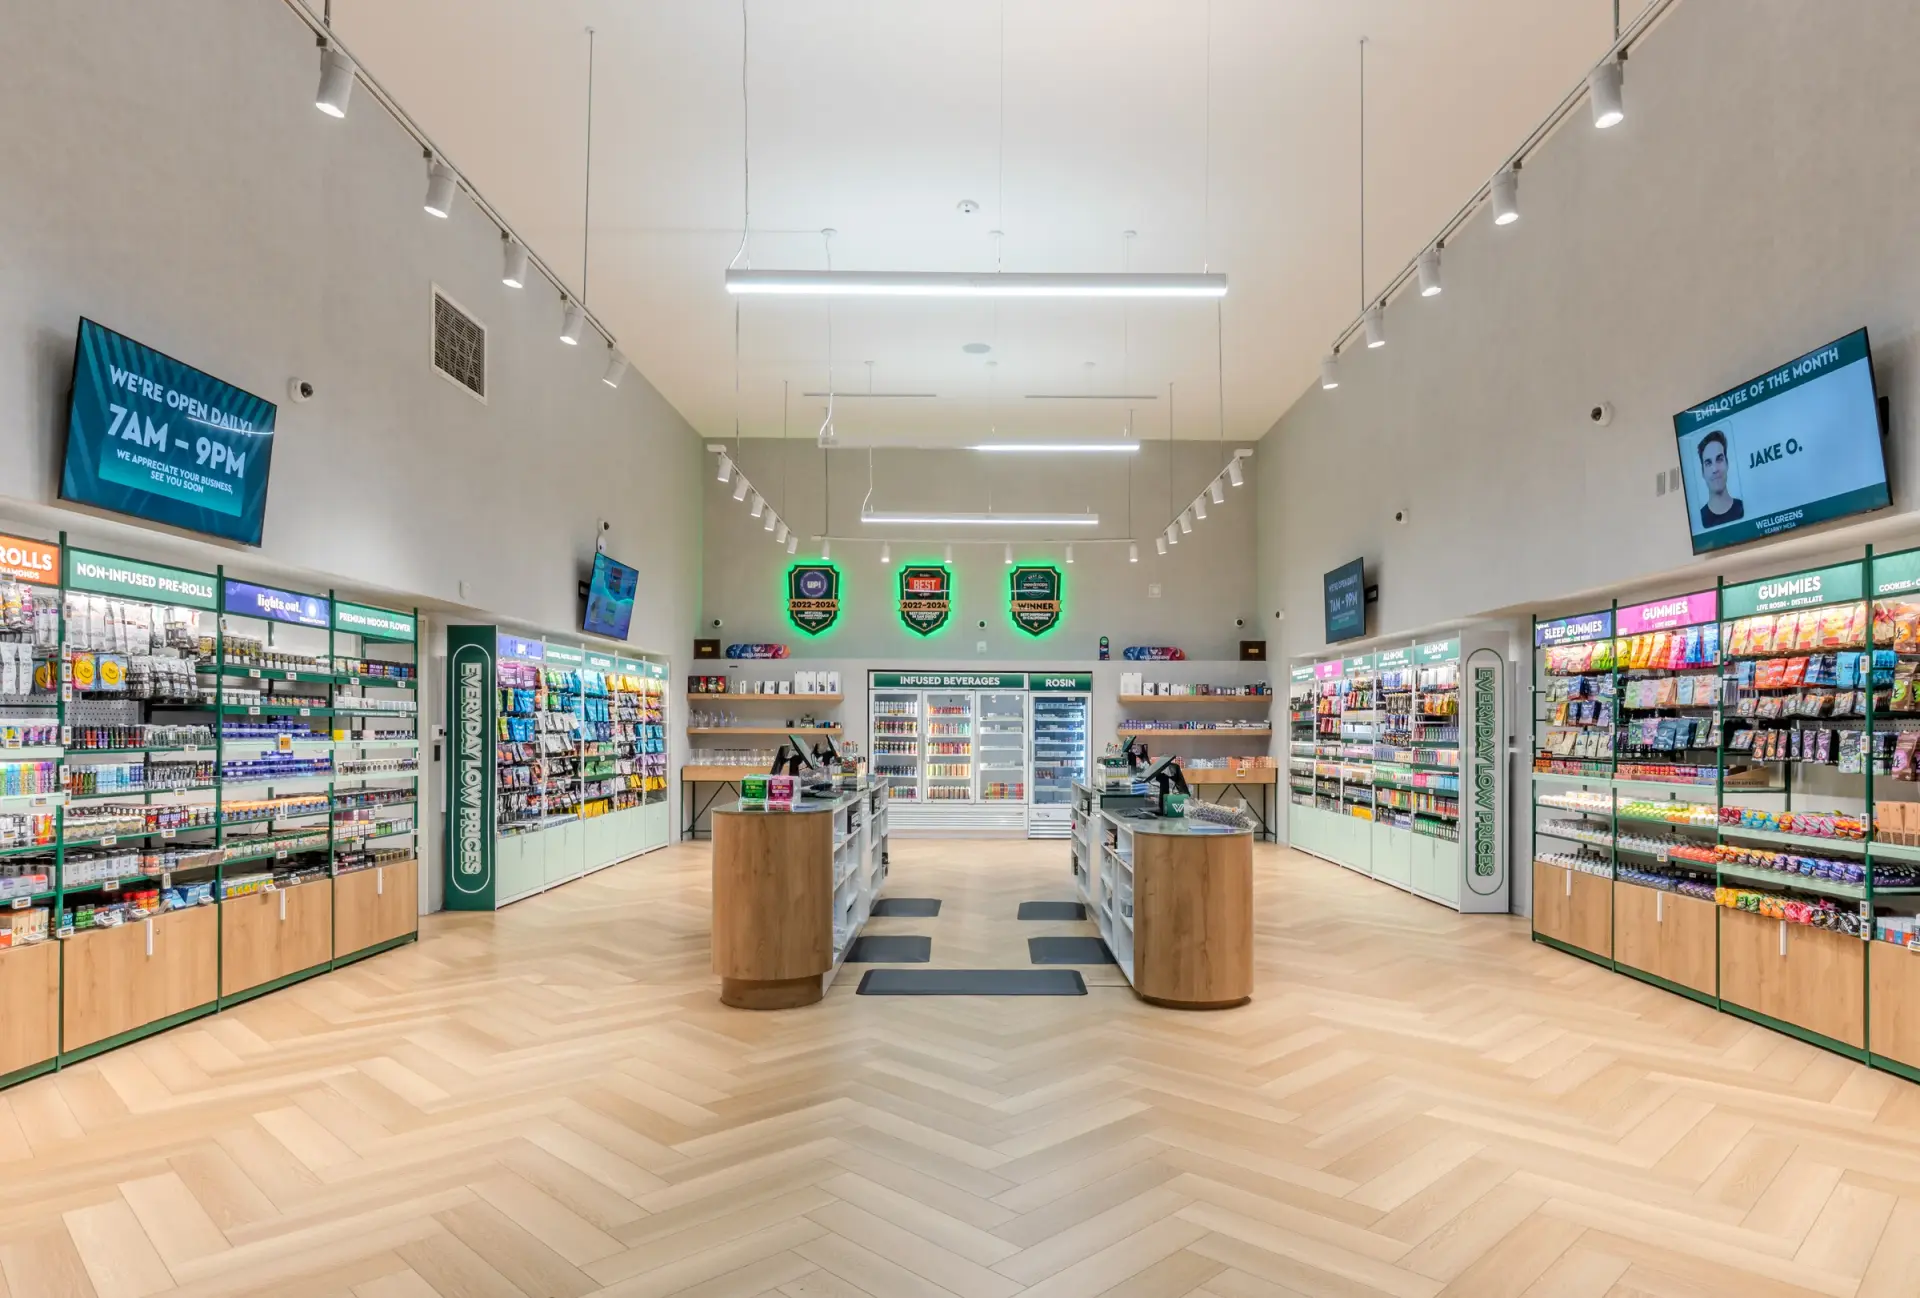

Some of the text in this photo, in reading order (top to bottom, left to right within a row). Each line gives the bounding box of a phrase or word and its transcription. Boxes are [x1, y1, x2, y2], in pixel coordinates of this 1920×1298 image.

[1695, 348, 1839, 422] EMPLOYEE OF THE MONTH
[110, 365, 252, 437] WE'RE OPEN DAILY!
[108, 403, 168, 452] 7AM
[196, 437, 246, 478] 9PM
[1749, 438, 1803, 469] JAKE O.
[117, 449, 234, 495] WE APPRECIATE YOUR BUSINESS,
[150, 470, 204, 493] SEE YOU SOON
[1756, 509, 1803, 530] WELLGREENS
[1783, 521, 1797, 531] MESA
[77, 563, 213, 599] NON-INFUSED PRE-ROLLS
[913, 580, 937, 590] BEST
[1758, 576, 1822, 600] GUMMIES
[1879, 580, 1911, 592] COOKIES
[257, 594, 302, 613] lights out.
[1345, 592, 1358, 608] 9PM
[1643, 601, 1688, 620] GUMMIES
[1757, 602, 1768, 611] LIVE
[1791, 595, 1824, 607] DISTILLATE
[339, 612, 411, 633] PREMIUM INDOOR FLOWER
[1544, 627, 1566, 640] SLEEP
[1567, 620, 1602, 636] GUMMIES
[900, 676, 1000, 686] INFUSED BEVERAGES
[1045, 679, 1076, 688] ROSIN
[460, 663, 482, 874] EVERYDAY LOW PRICES
[1475, 667, 1495, 876] EVERYDAY LOW PRICES
